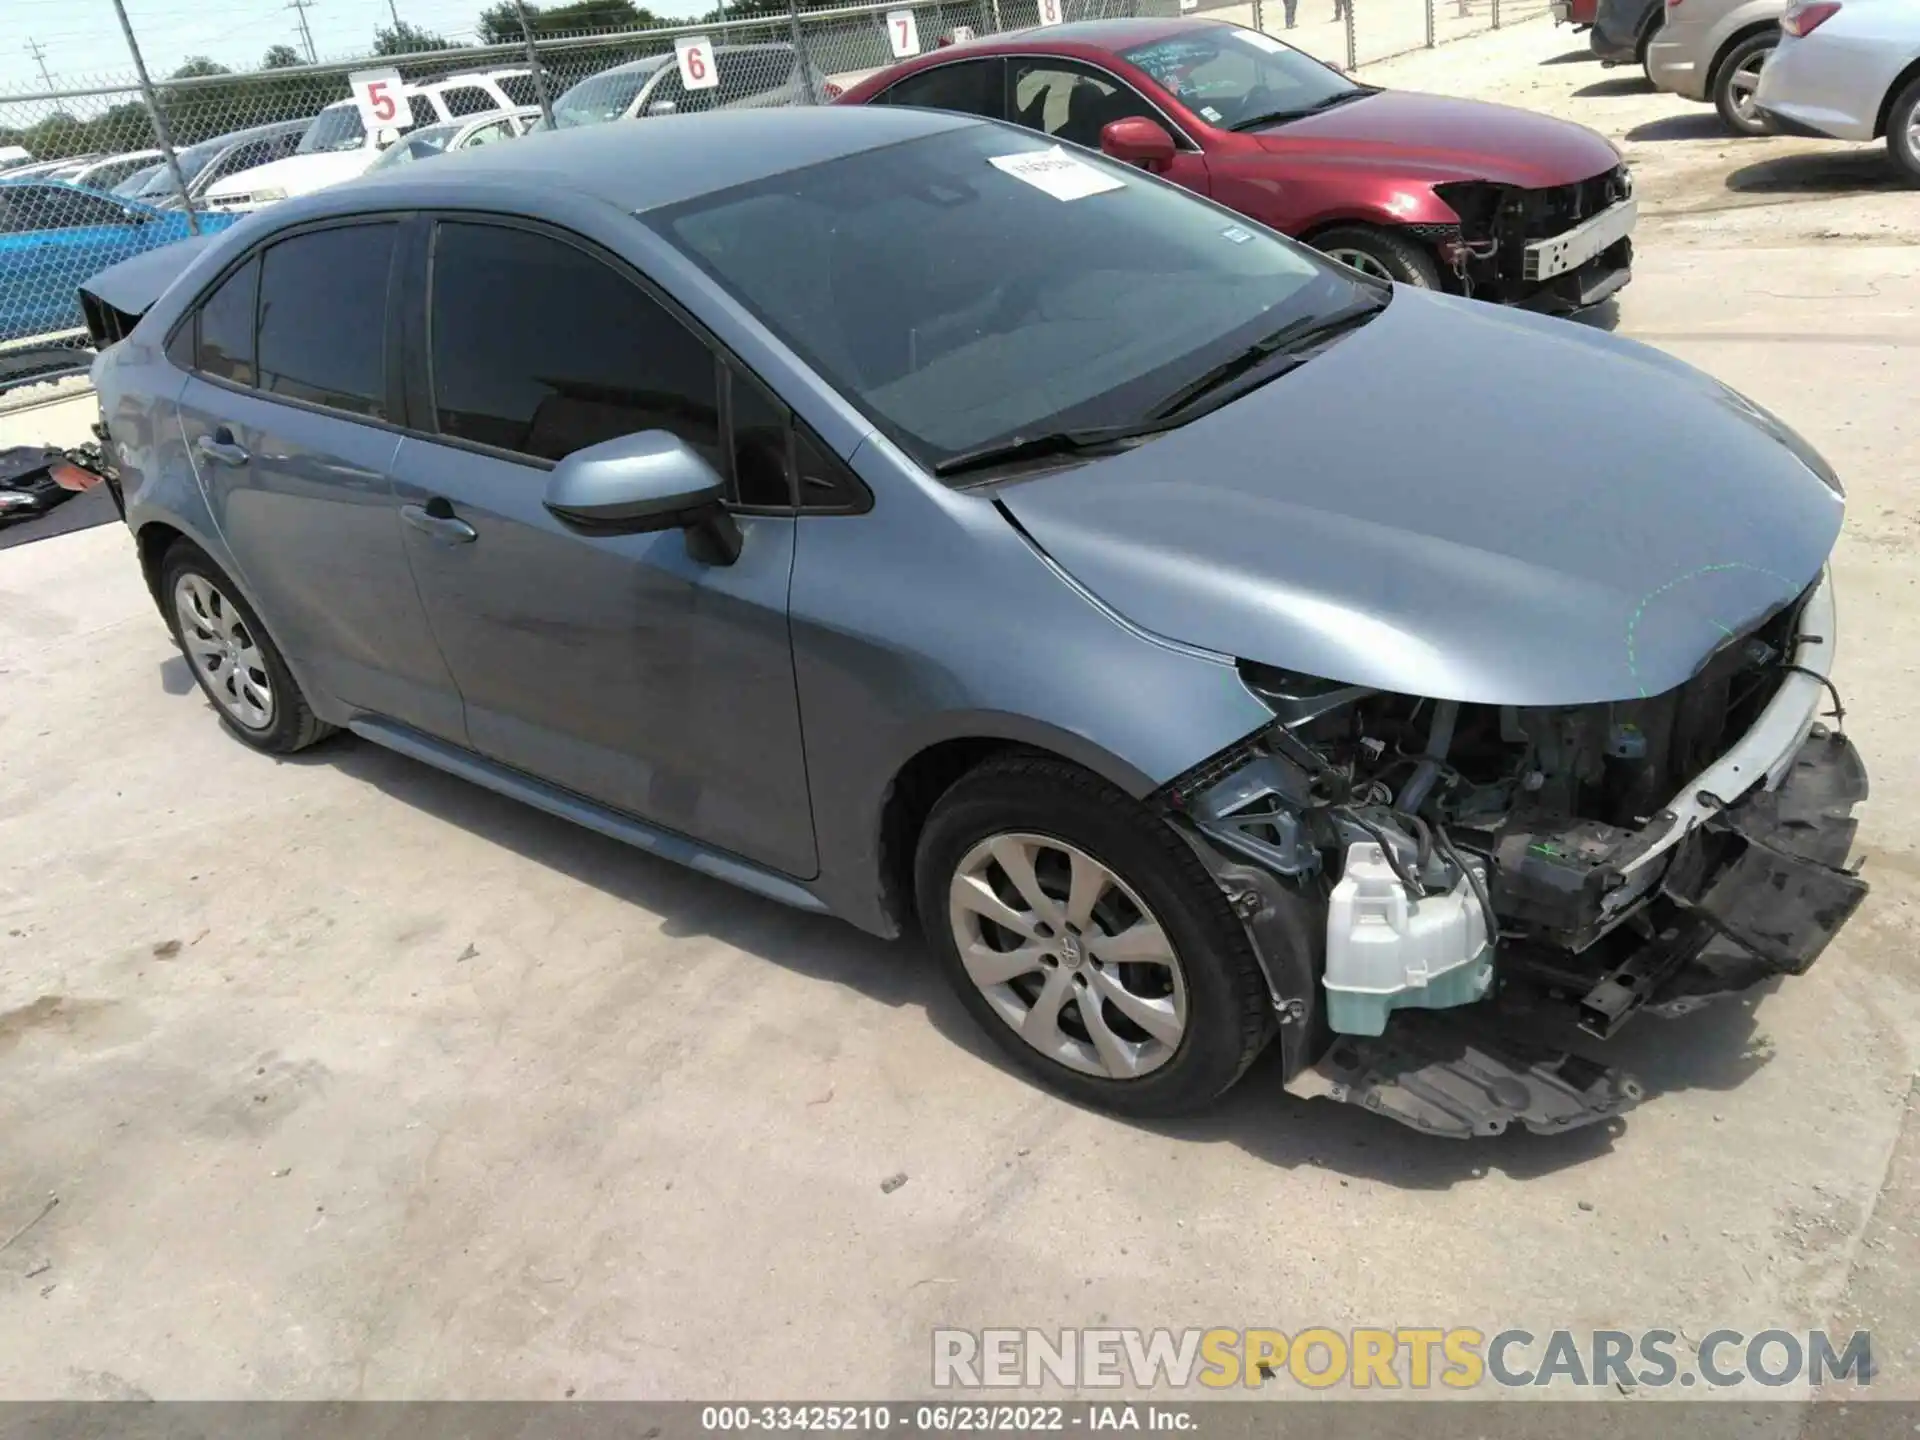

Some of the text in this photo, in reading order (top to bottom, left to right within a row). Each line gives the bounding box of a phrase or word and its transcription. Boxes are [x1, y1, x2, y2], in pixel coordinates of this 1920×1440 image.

[1045, 0, 1056, 22] 8
[895, 20, 908, 49] 7
[687, 47, 706, 80] 6
[367, 82, 396, 121] 5
